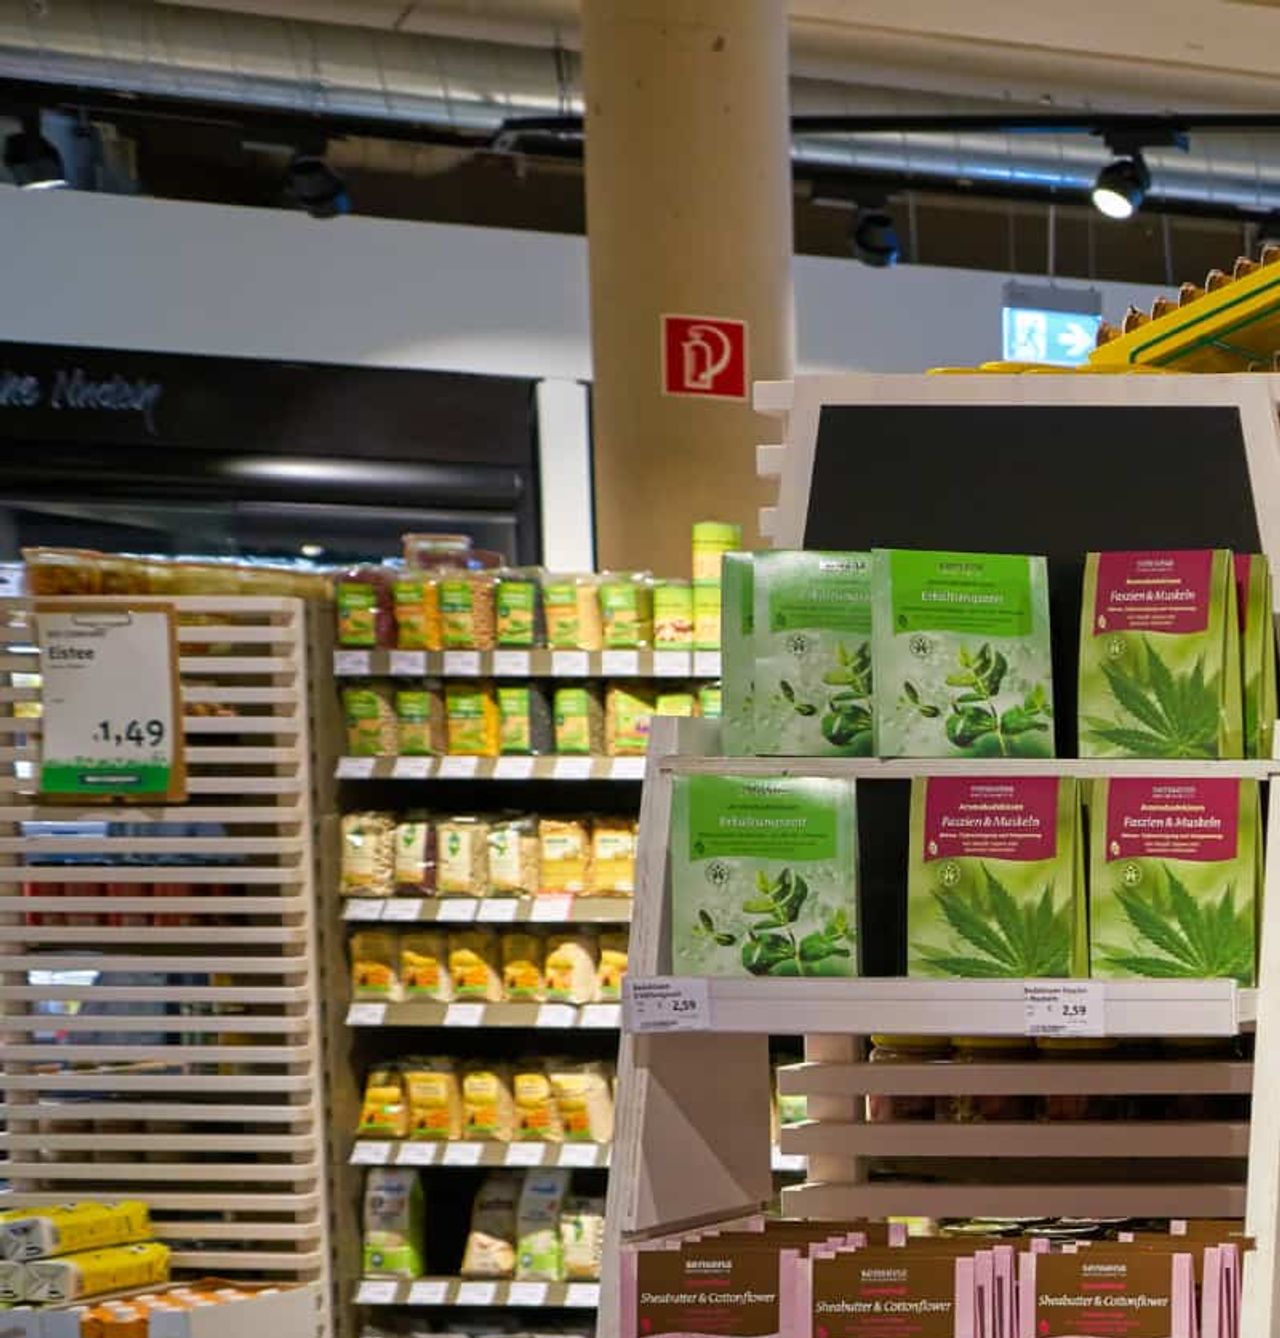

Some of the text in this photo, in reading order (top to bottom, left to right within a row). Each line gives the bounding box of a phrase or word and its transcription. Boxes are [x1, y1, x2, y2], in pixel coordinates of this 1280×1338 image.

[48, 646, 95, 660] Eistee
[99, 719, 164, 747] 1,49
[993, 816, 1040, 827] Muskeln
